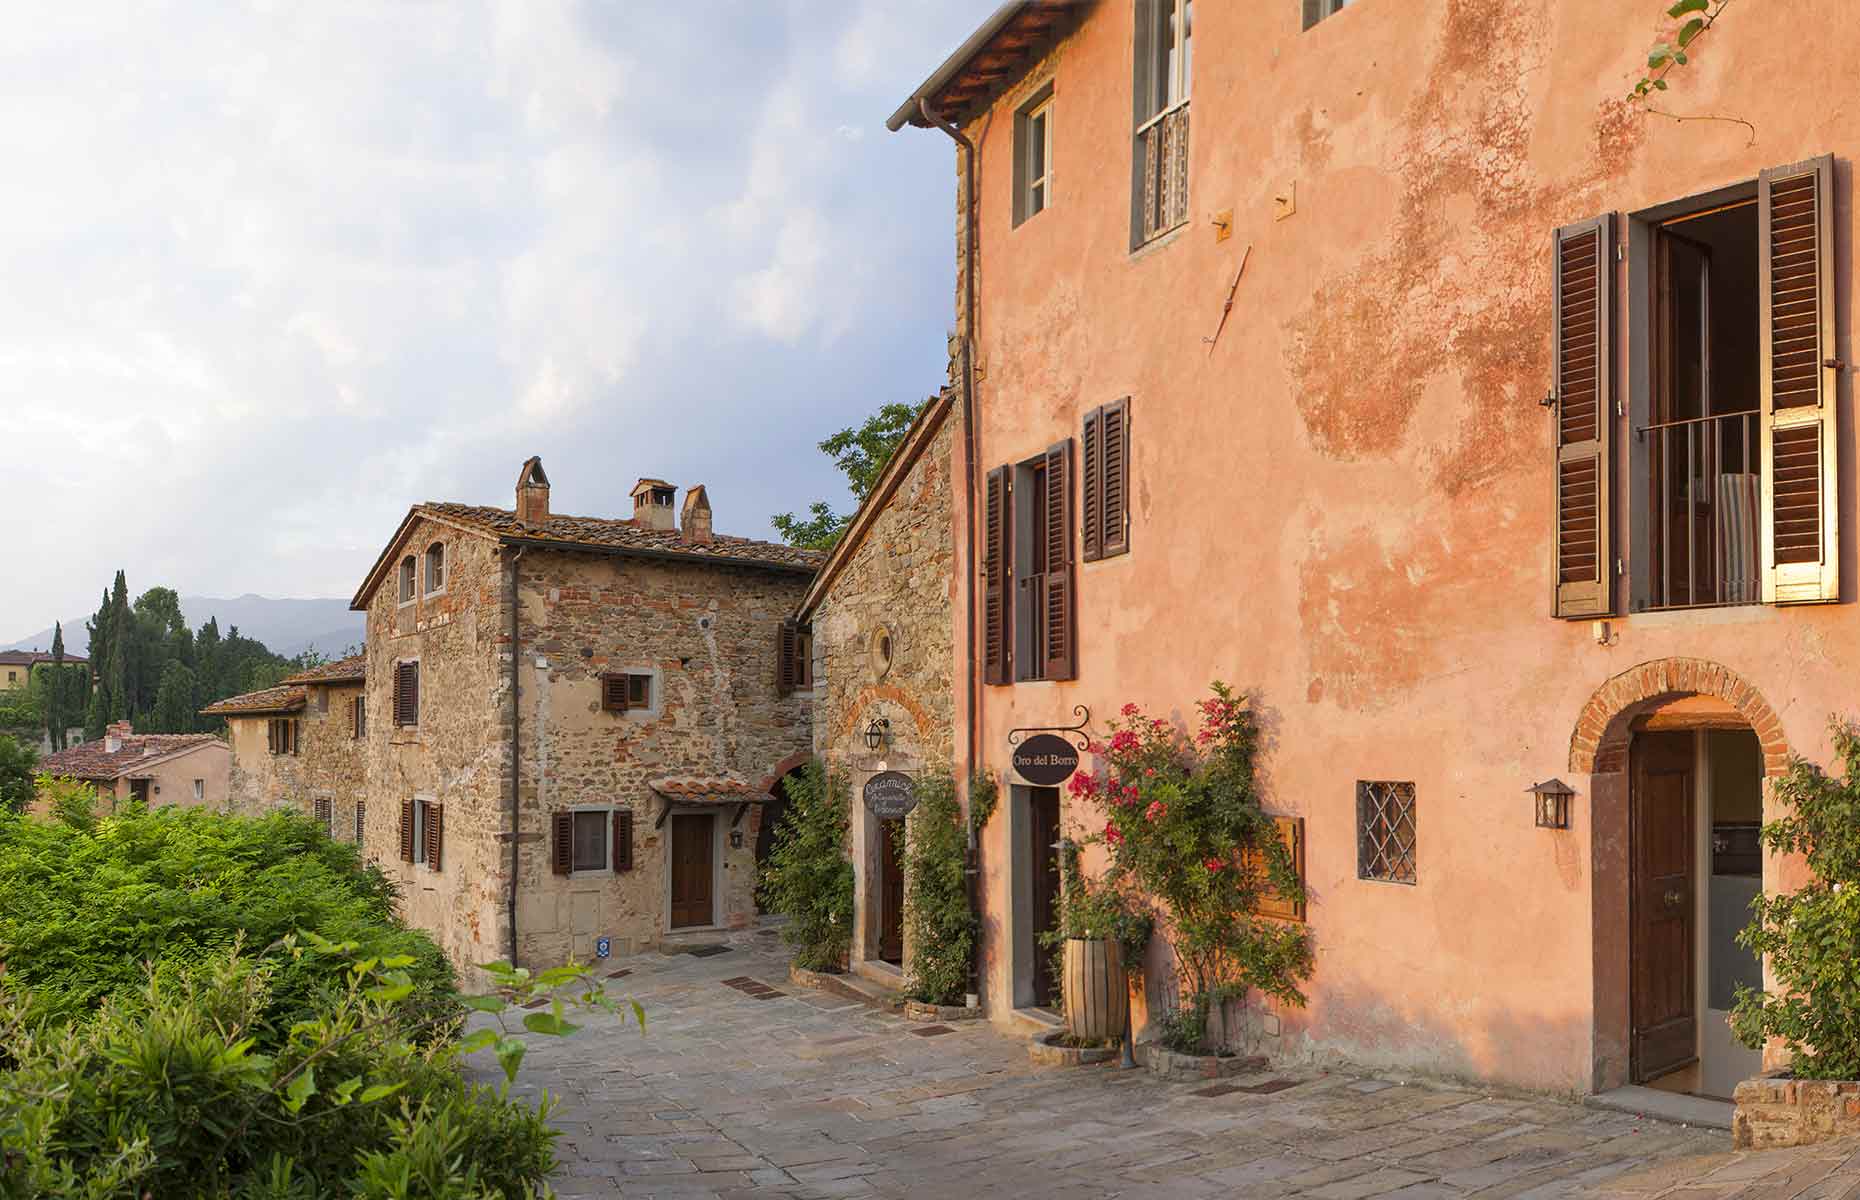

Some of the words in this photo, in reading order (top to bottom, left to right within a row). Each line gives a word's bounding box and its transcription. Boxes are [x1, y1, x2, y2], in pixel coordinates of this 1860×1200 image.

[1014, 754, 1031, 766] Oro
[1033, 754, 1048, 766] del
[1050, 754, 1078, 766] Borro
[865, 778, 913, 794] Ceramich
